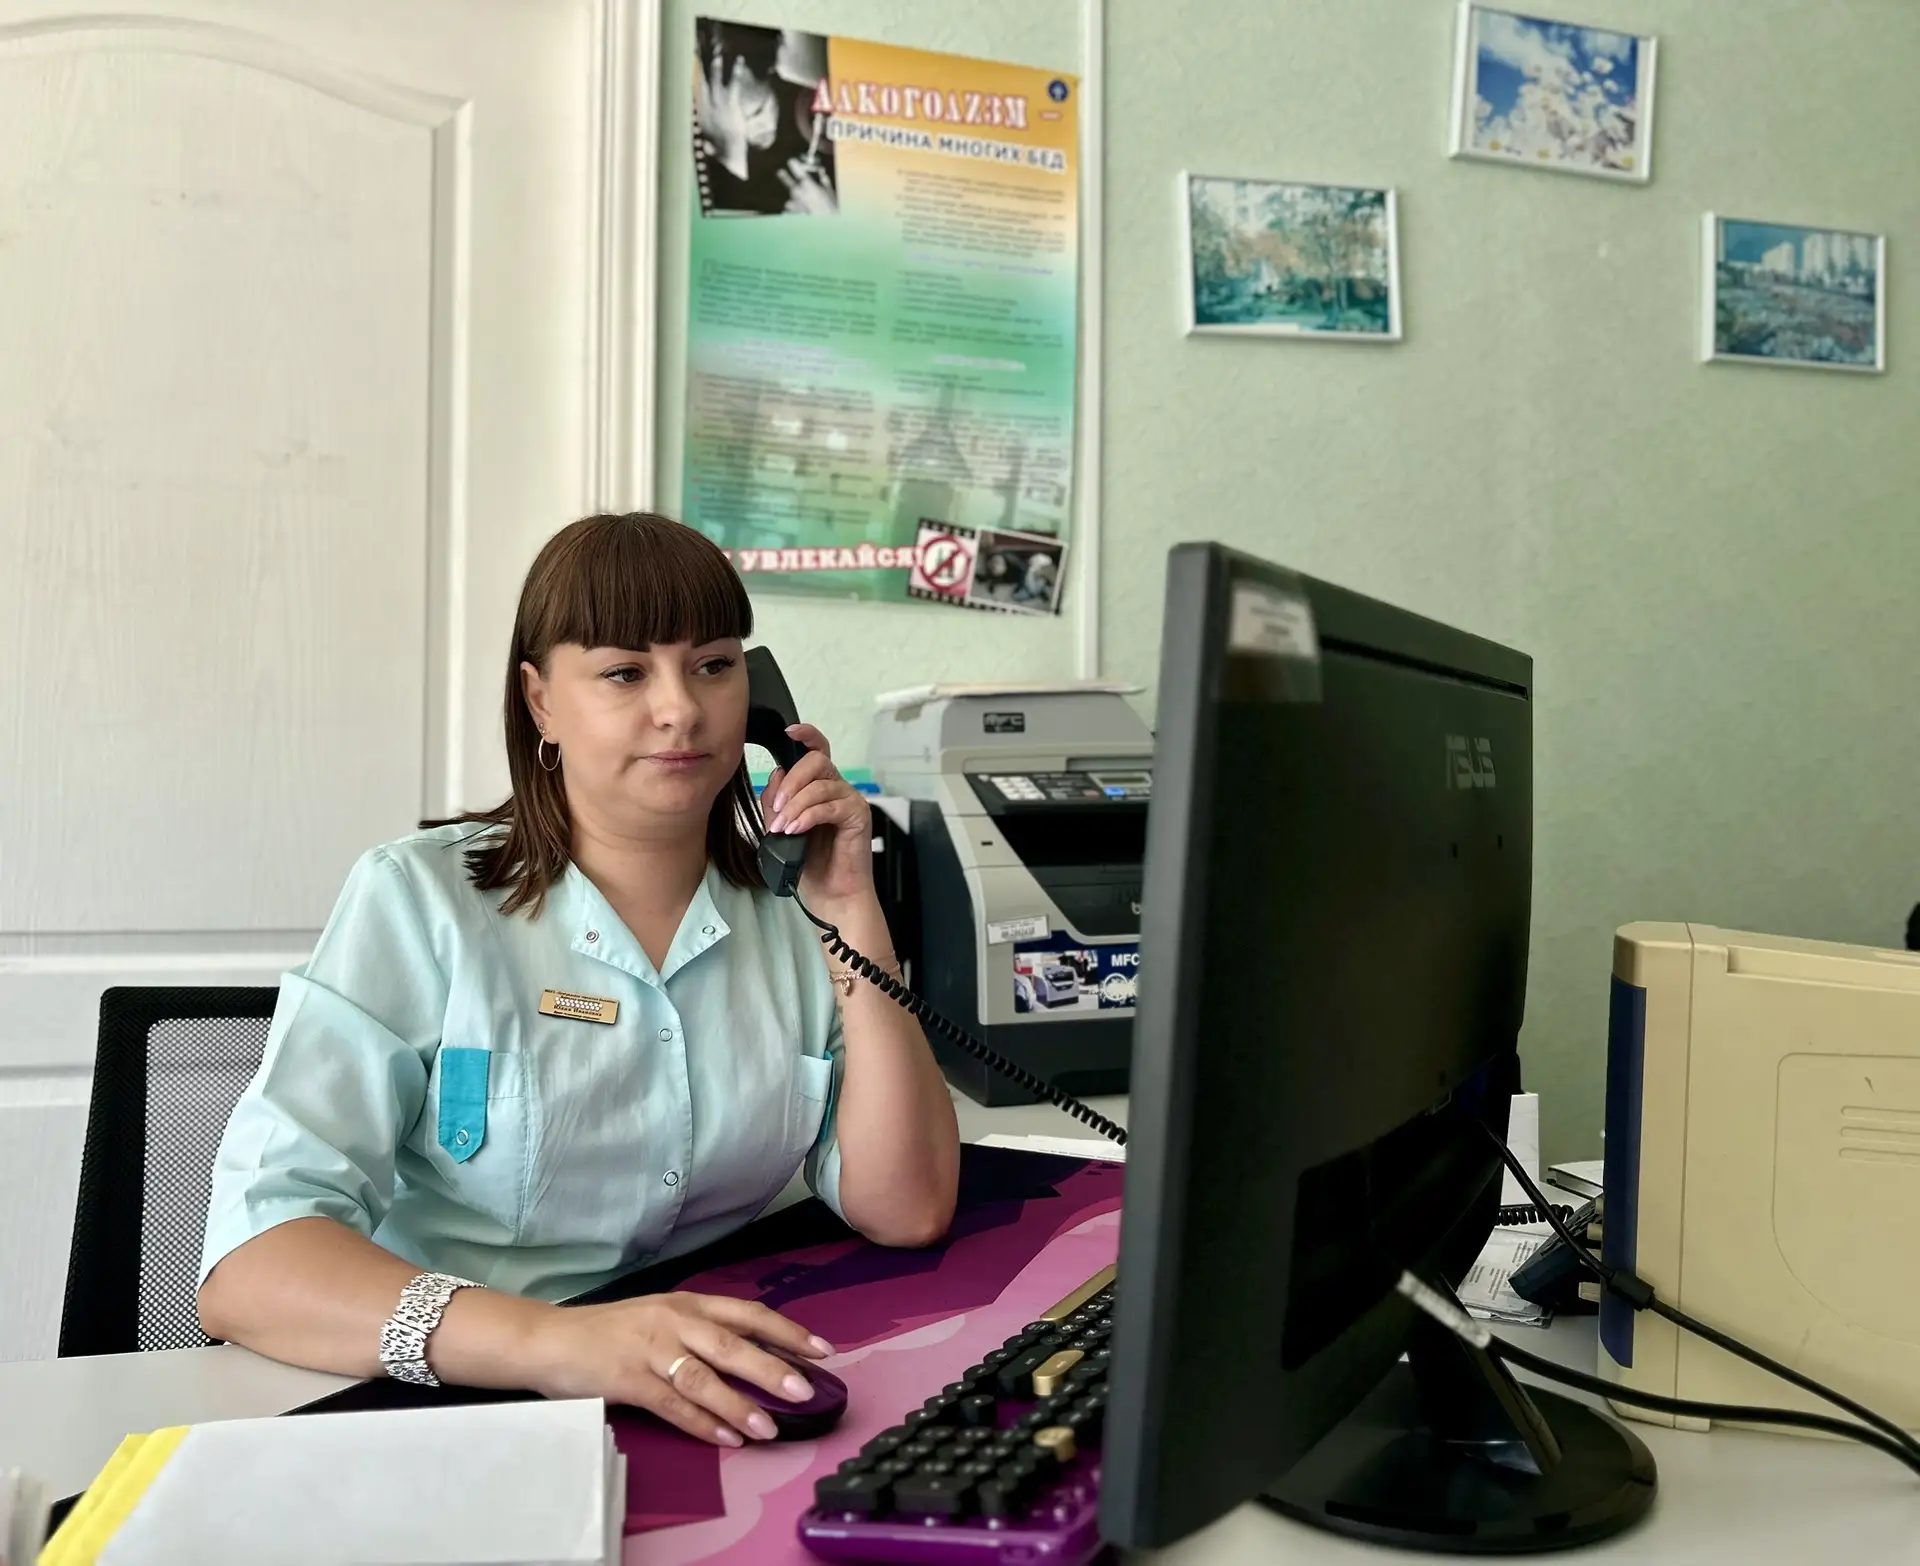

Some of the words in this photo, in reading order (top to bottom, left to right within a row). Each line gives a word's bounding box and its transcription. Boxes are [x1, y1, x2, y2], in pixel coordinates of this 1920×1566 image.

[829, 119, 934, 149] ПРИЧИНА
[939, 135, 1023, 165] МНОГИХ
[1027, 149, 1066, 171] БЕД
[1111, 953, 1141, 967] MFC
